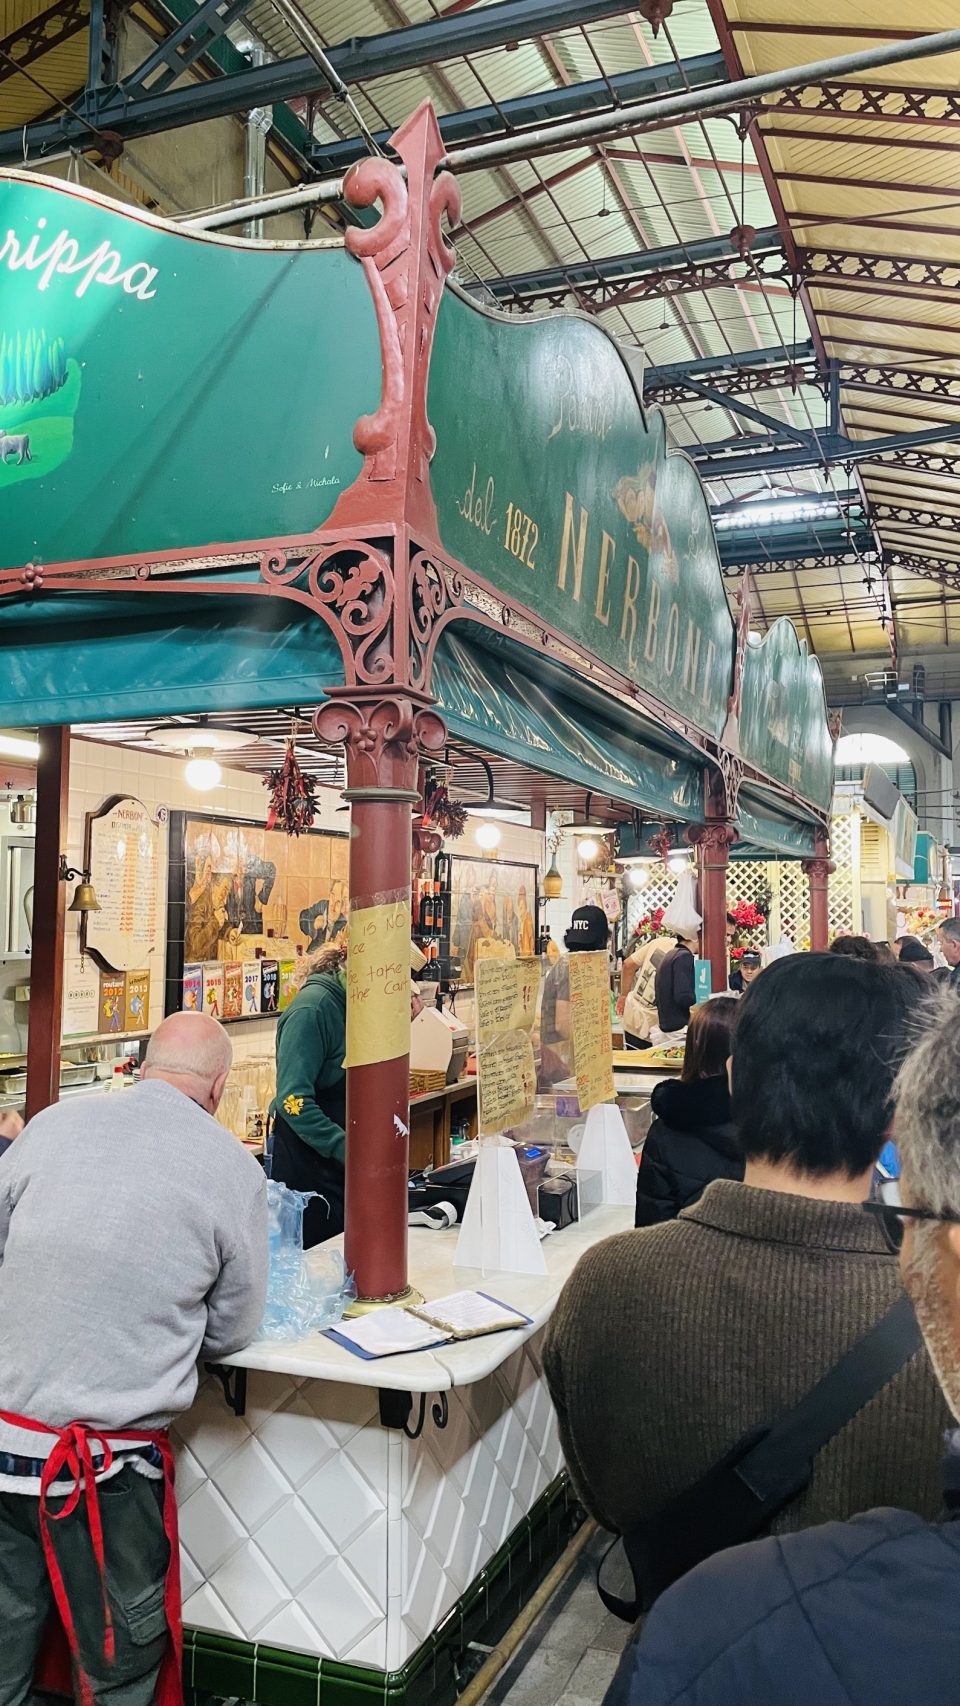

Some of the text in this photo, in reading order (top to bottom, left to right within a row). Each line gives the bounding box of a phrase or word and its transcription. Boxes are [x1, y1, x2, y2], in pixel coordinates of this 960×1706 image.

[504, 501, 539, 570] 1872
[386, 913, 406, 931] NO
[572, 919, 589, 930] NYC
[245, 975, 259, 983] 2017
[367, 962, 402, 982] take
[104, 988, 123, 996] 2012
[129, 985, 148, 994] 2013
[350, 986, 370, 1003] the
